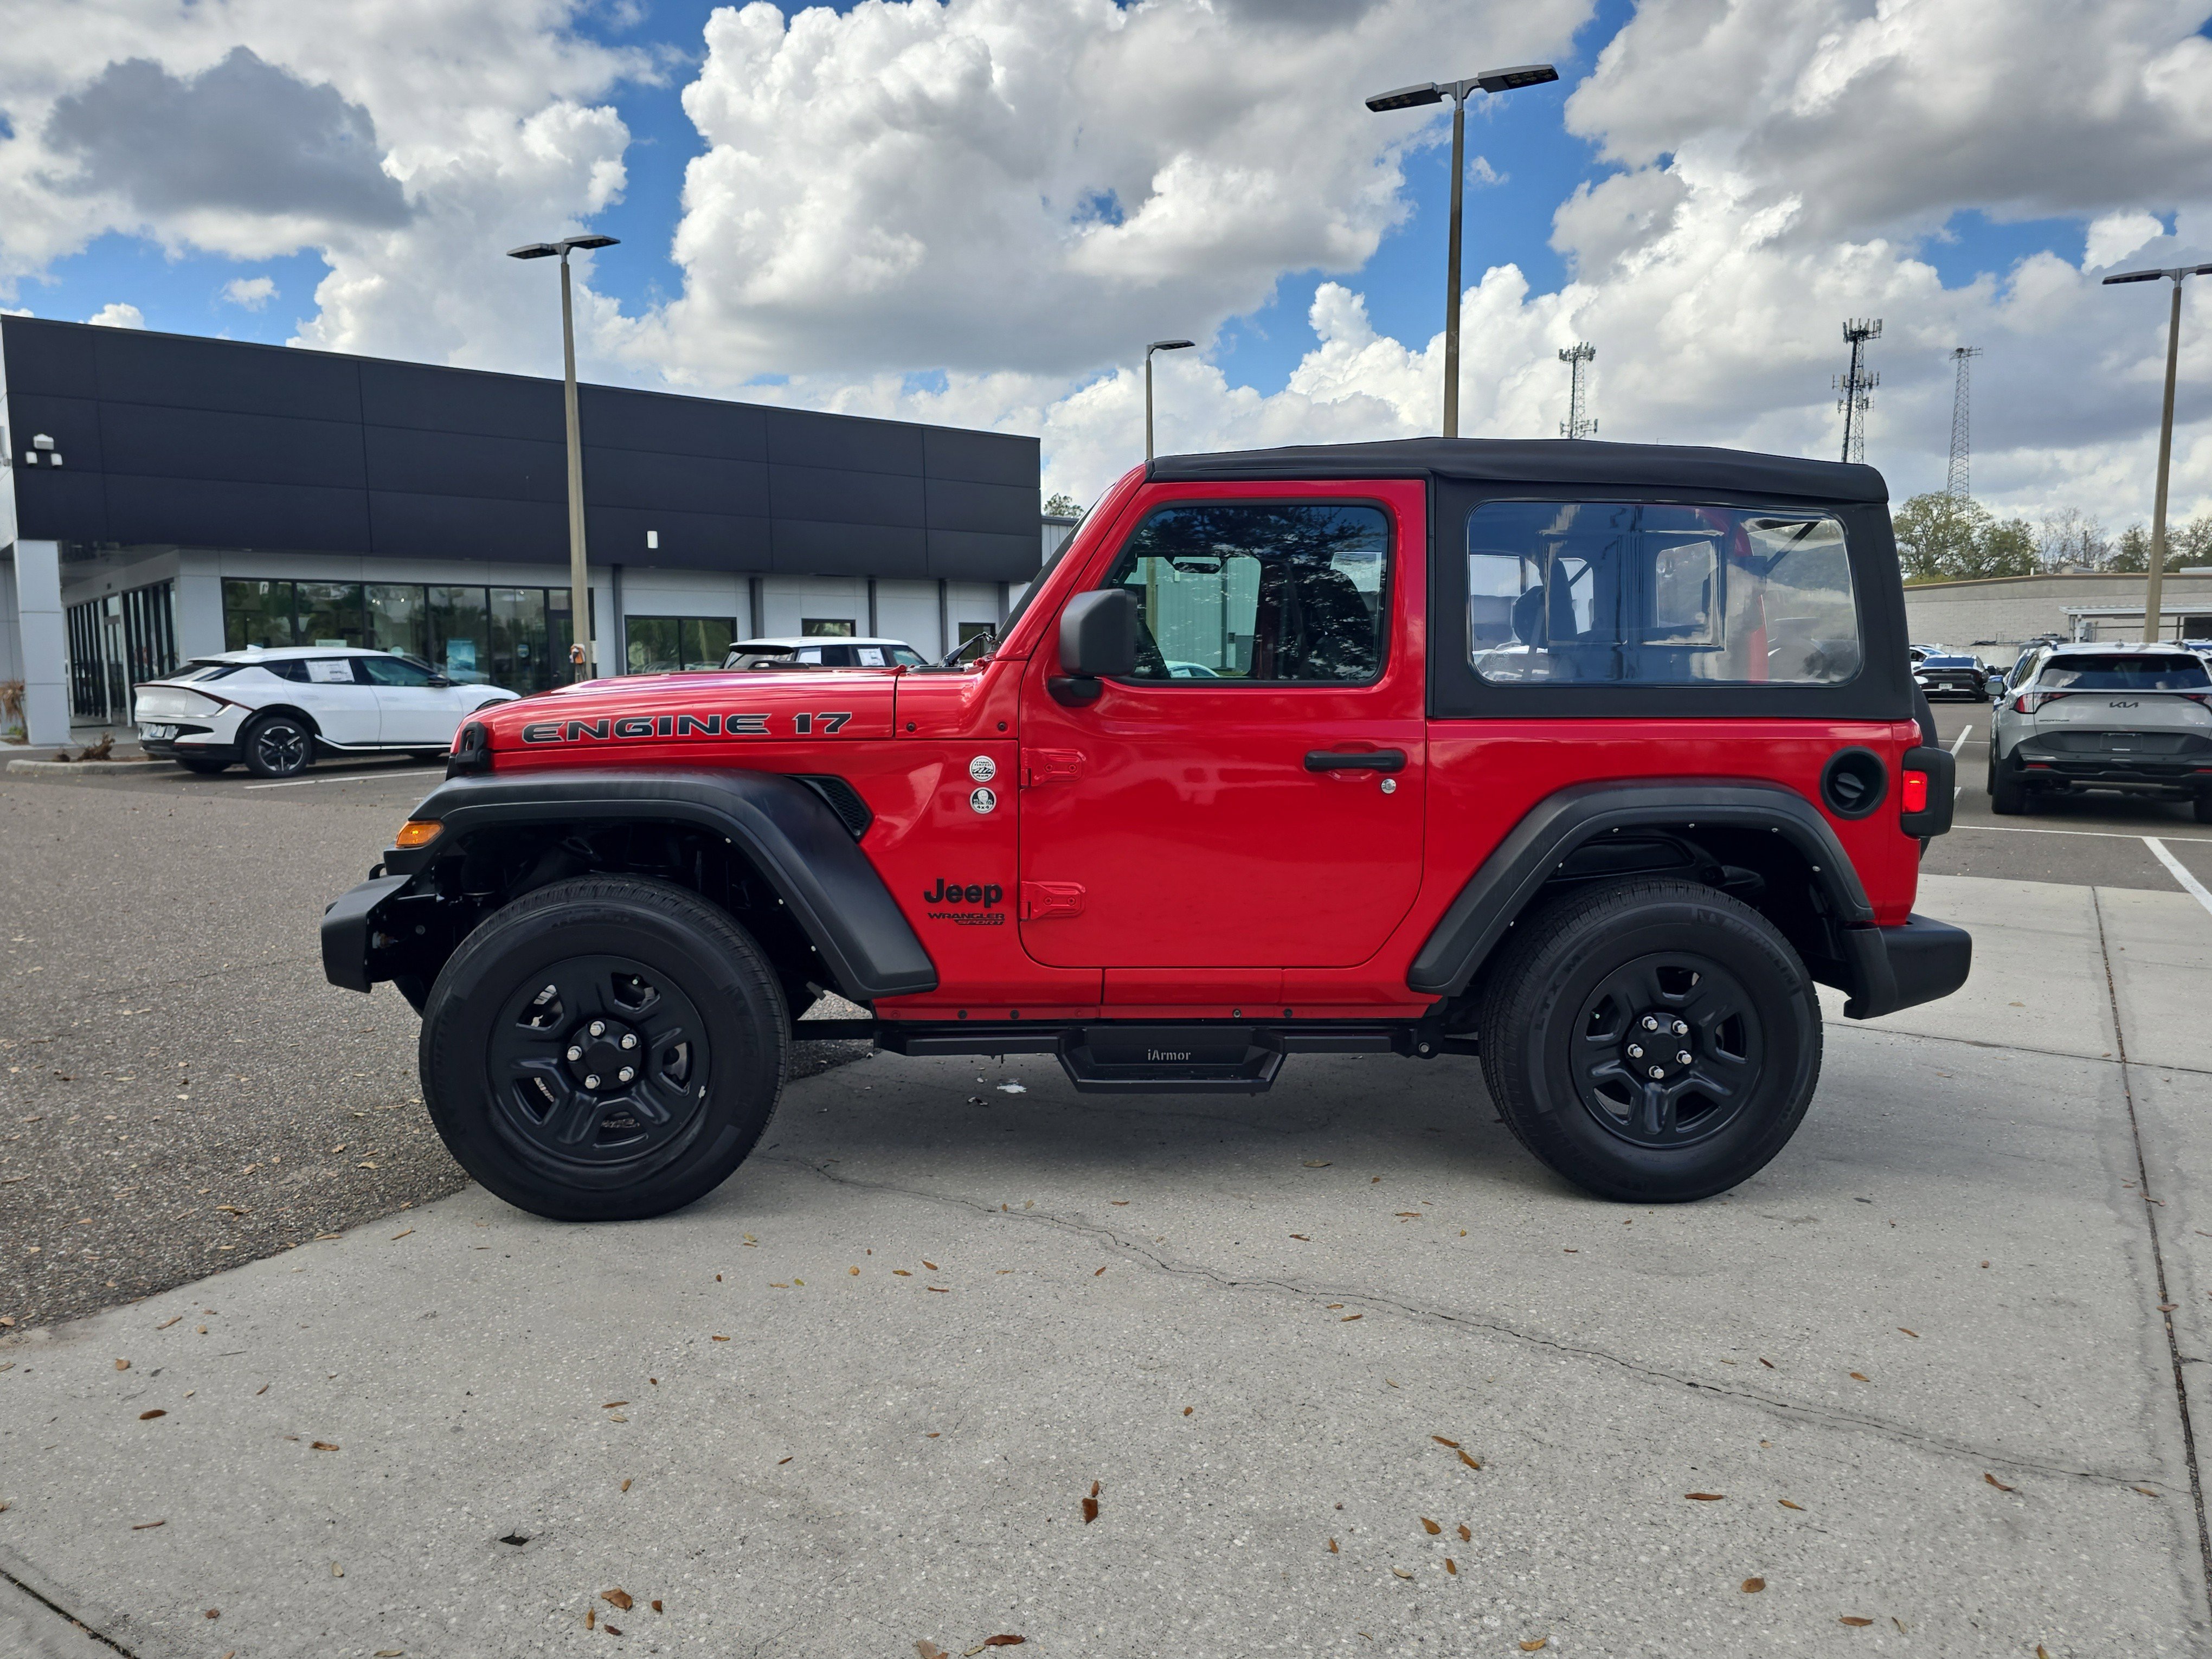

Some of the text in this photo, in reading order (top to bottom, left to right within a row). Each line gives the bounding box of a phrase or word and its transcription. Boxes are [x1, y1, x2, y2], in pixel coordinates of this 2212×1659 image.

[522, 712, 853, 744] ENGINE 17
[924, 878, 1003, 909] Jeep
[1721, 916, 1798, 987] MICHELIN
[1534, 982, 1561, 1031] LTX
[1147, 1049, 1191, 1060] iArmor
